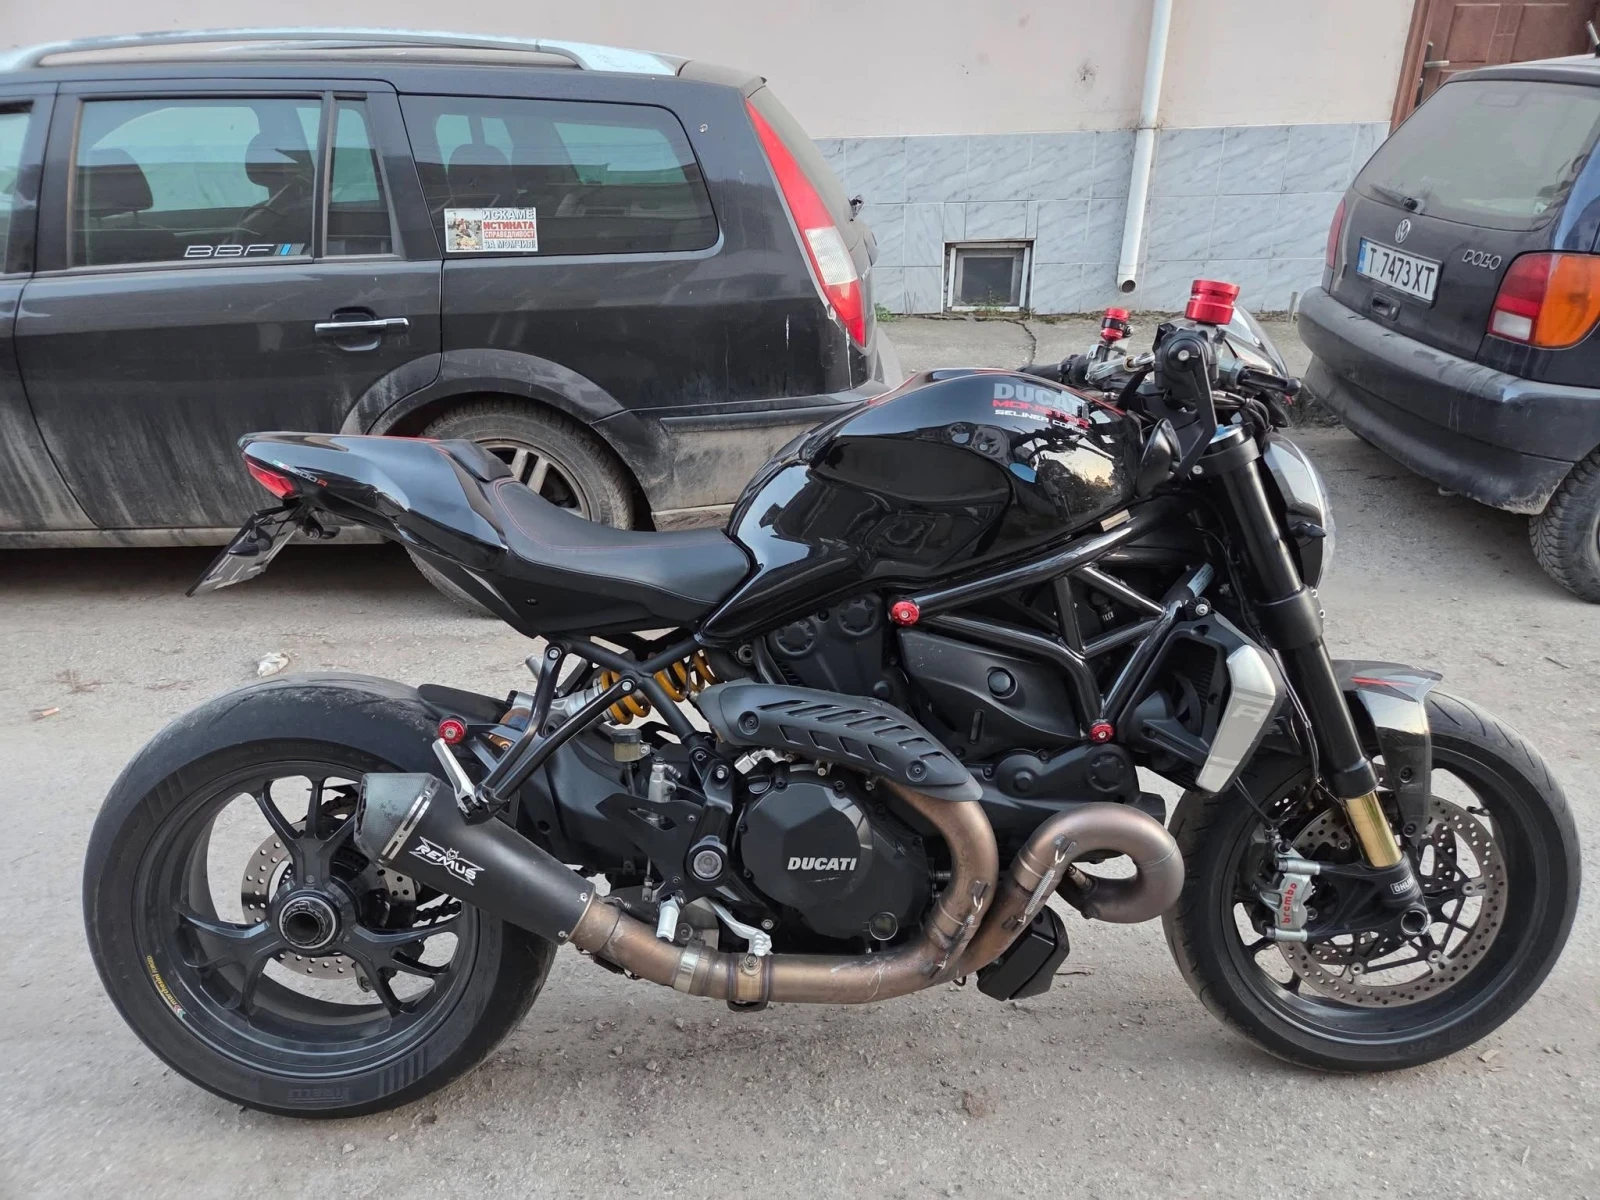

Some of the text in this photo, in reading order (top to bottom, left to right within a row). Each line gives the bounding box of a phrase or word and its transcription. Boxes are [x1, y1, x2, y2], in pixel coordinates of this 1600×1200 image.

[482, 209, 535, 221] ИСКАМЕ
[483, 221, 535, 230] ИСТИНАТА
[484, 230, 535, 239] СПРАВЕДЛИВОСТ
[183, 243, 275, 258] BBF
[484, 240, 495, 249] ЗА
[1462, 249, 1502, 271] POLO
[992, 400, 1090, 429] MONSTER
[994, 409, 1050, 423] SELINER
[1231, 704, 1267, 723] R
[414, 844, 477, 880] REMUS
[787, 857, 857, 871] DUCATI
[1281, 882, 1298, 924] brembo
